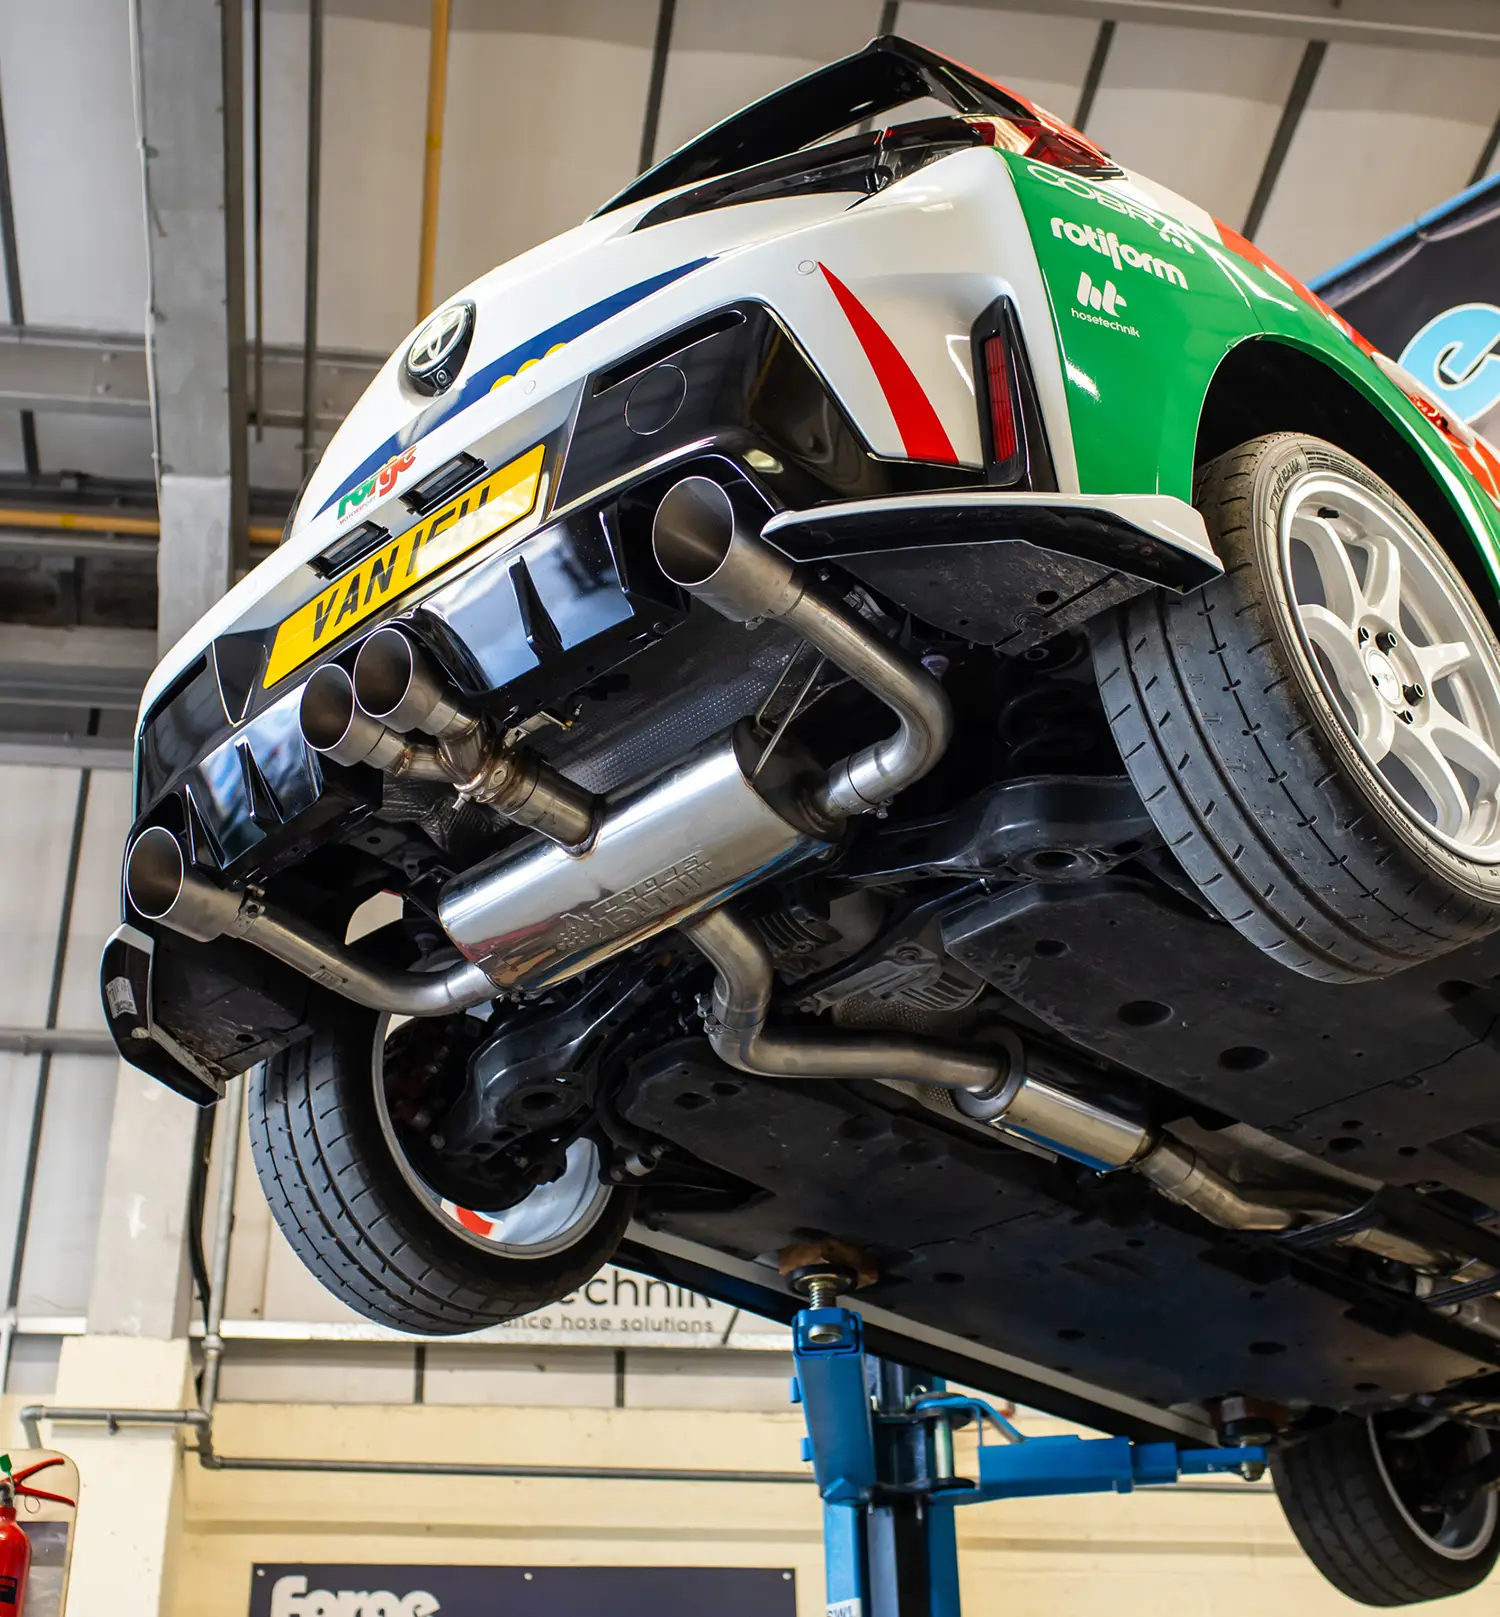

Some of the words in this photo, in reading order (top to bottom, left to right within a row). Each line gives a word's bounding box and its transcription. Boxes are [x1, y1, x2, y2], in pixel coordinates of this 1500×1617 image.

[1027, 164, 1192, 247] COBRA
[1050, 216, 1190, 290] rotiform
[1071, 307, 1140, 338] hosetechnik
[312, 545, 400, 642] VAN
[561, 1314, 612, 1330] hose
[620, 1316, 713, 1332] solutions
